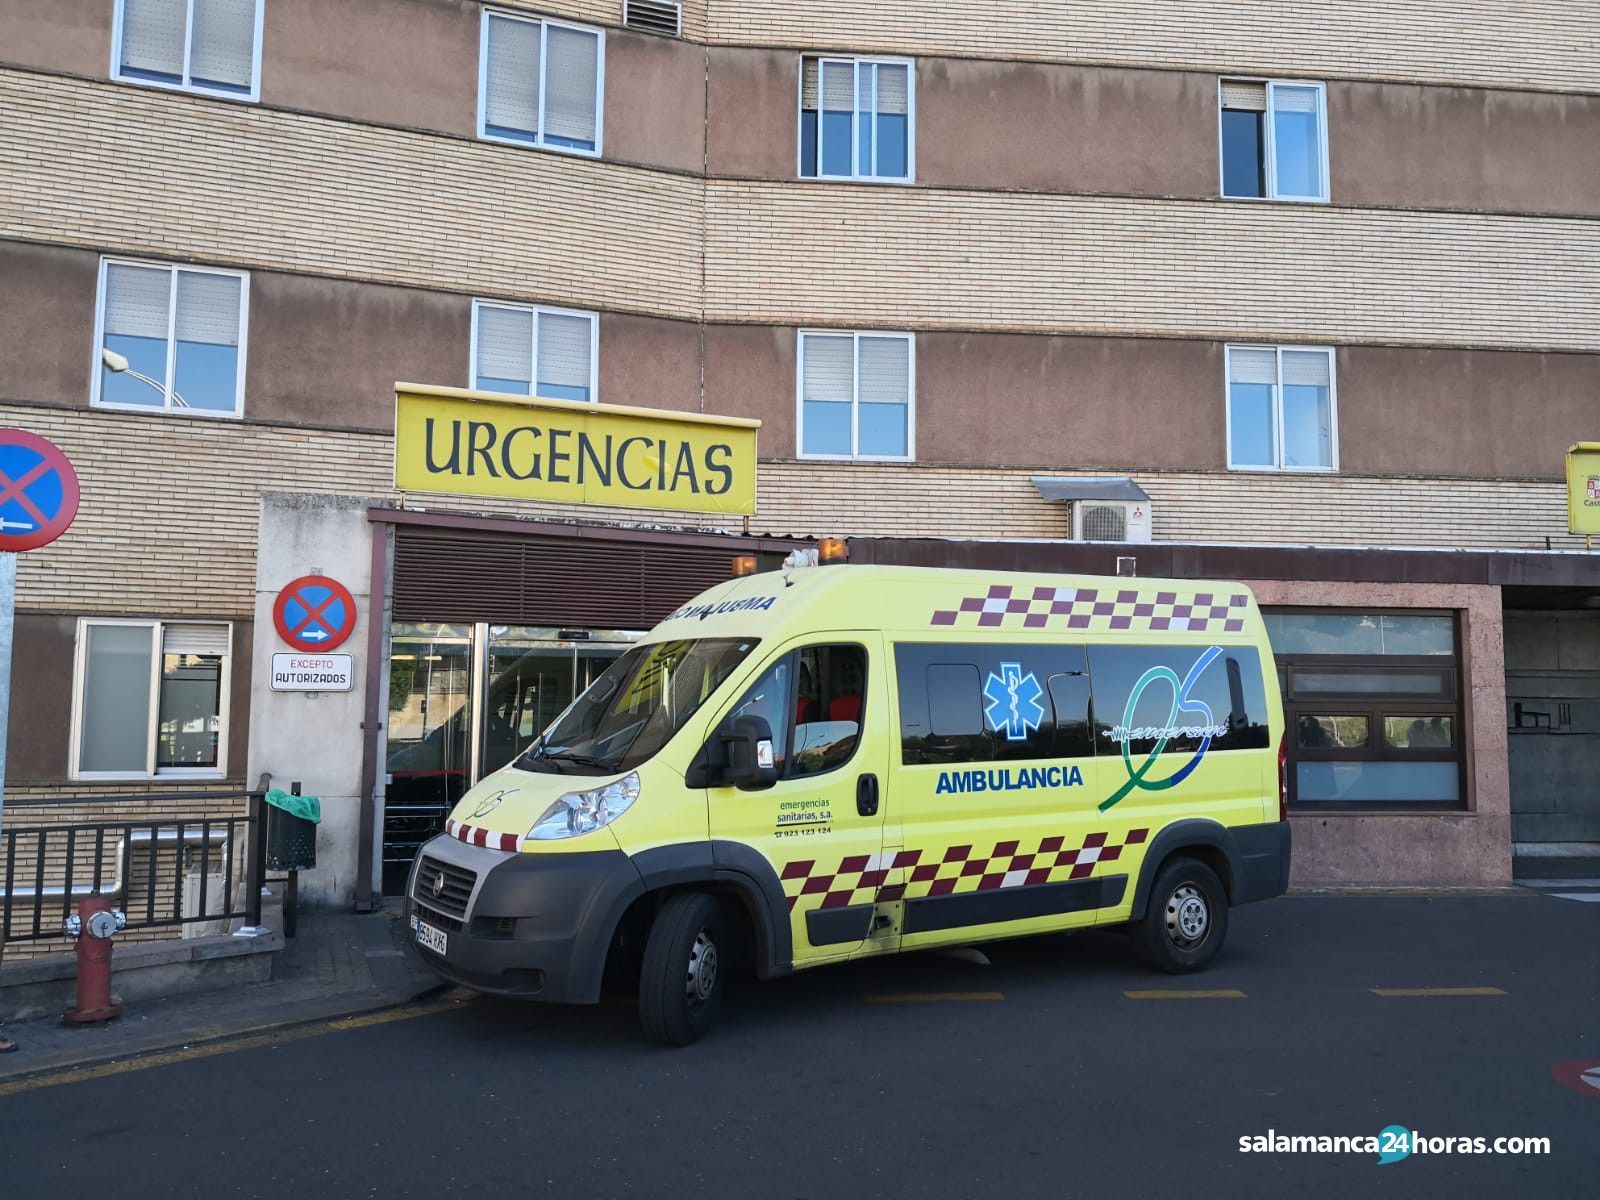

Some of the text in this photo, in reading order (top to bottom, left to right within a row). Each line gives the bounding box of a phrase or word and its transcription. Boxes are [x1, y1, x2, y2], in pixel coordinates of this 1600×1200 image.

[425, 418, 733, 495] URGENCIAS
[290, 659, 334, 669] EXCEPTO
[275, 673, 346, 683] AUTORIZADOS
[936, 765, 1083, 794] AMBULANCIA
[780, 798, 830, 810] emergencias
[777, 811, 833, 822] sanitarias, s.a.
